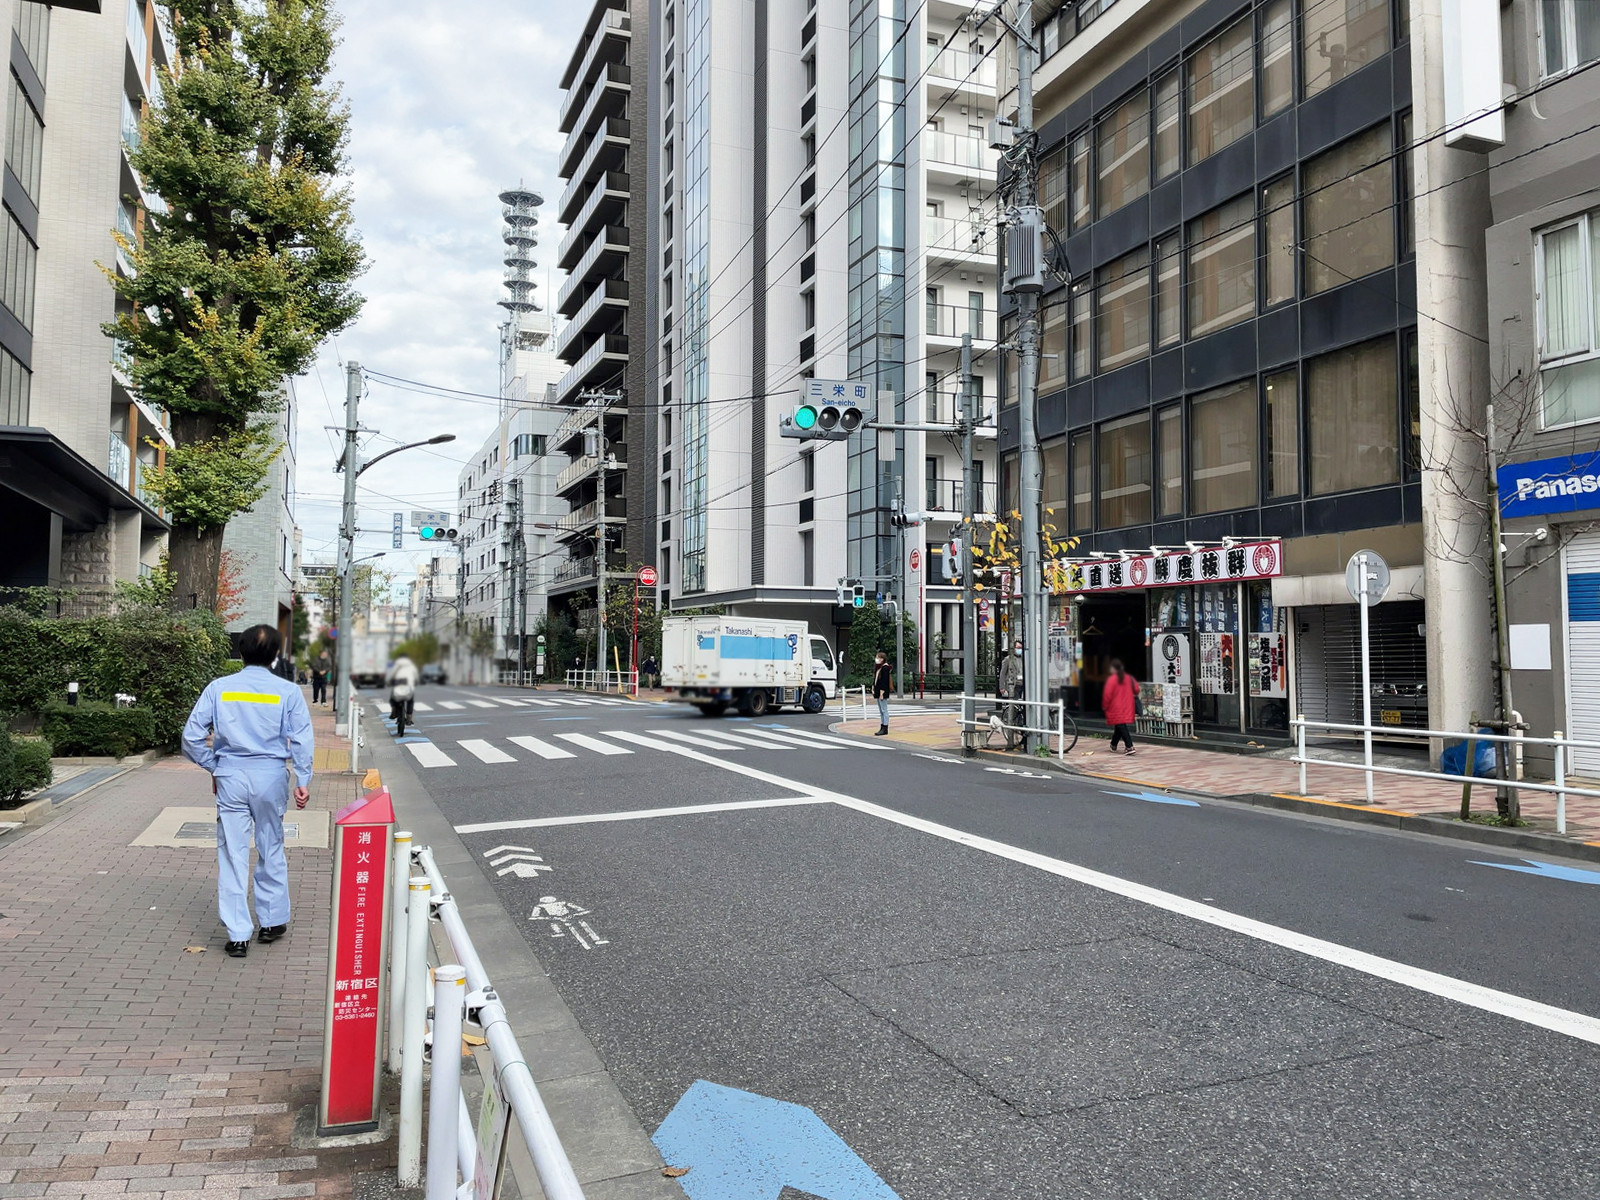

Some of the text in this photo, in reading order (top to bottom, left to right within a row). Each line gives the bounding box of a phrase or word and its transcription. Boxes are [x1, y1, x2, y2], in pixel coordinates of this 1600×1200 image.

[811, 383, 867, 399] 三栄町
[821, 397, 856, 407] San-eicho
[1516, 474, 1600, 501] Panas
[1153, 546, 1247, 584] 鮮度抜群
[725, 626, 753, 636] Takanashi
[356, 831, 371, 884] 消火器
[353, 886, 366, 976] FIRE EXTINGUISHER
[335, 978, 378, 991] 新宿区
